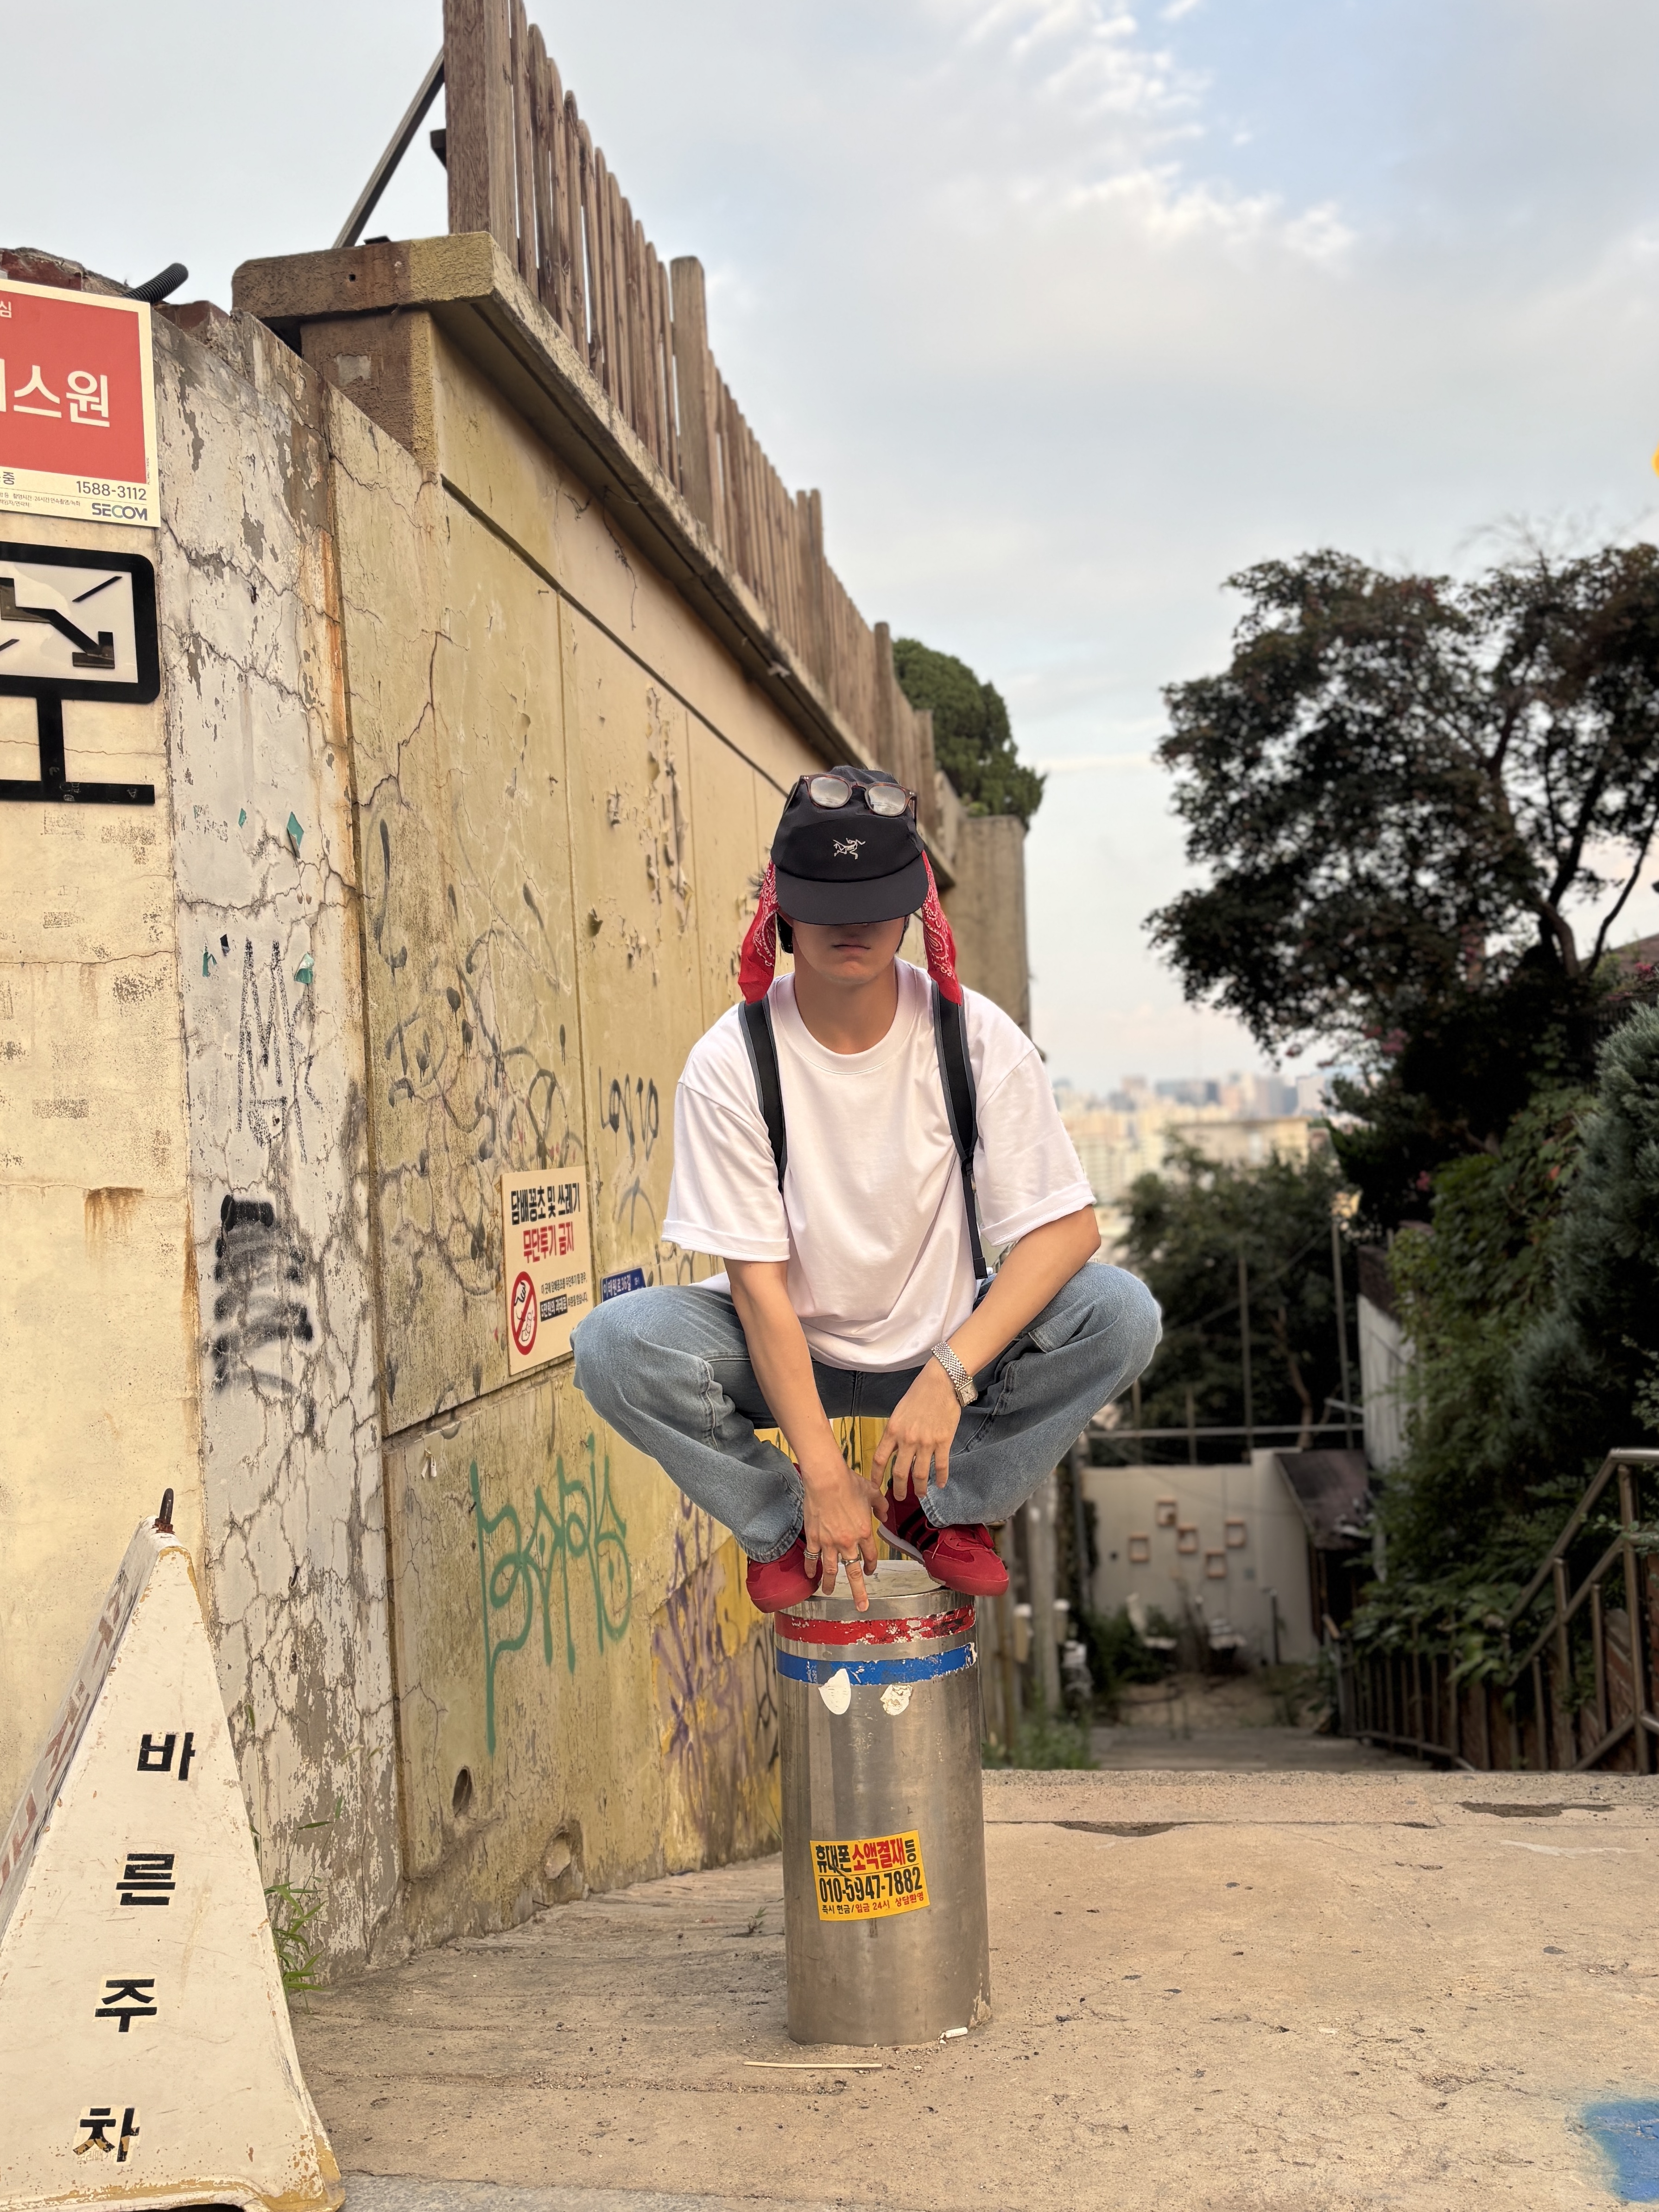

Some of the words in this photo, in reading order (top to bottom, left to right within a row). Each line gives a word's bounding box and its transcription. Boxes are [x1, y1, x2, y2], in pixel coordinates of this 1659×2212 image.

[0, 472, 15, 485] 중
[76, 481, 147, 501] 1588-3112
[92, 502, 148, 521] SECOM
[511, 1185, 546, 1225] 담배꽁초
[547, 1185, 556, 1219] 및
[557, 1182, 580, 1216] 쓰레기
[523, 1225, 557, 1264] 무단투기
[558, 1221, 574, 1256] 금지
[815, 1844, 852, 1873] 휴대폰
[852, 1838, 906, 1871] 소액결재
[905, 1839, 917, 1863] 등
[819, 1866, 923, 1903] 010-5947-7882
[822, 1904, 835, 1914] 즉시
[873, 1900, 890, 1911] 24시
[895, 1891, 924, 1907] 상담환영
